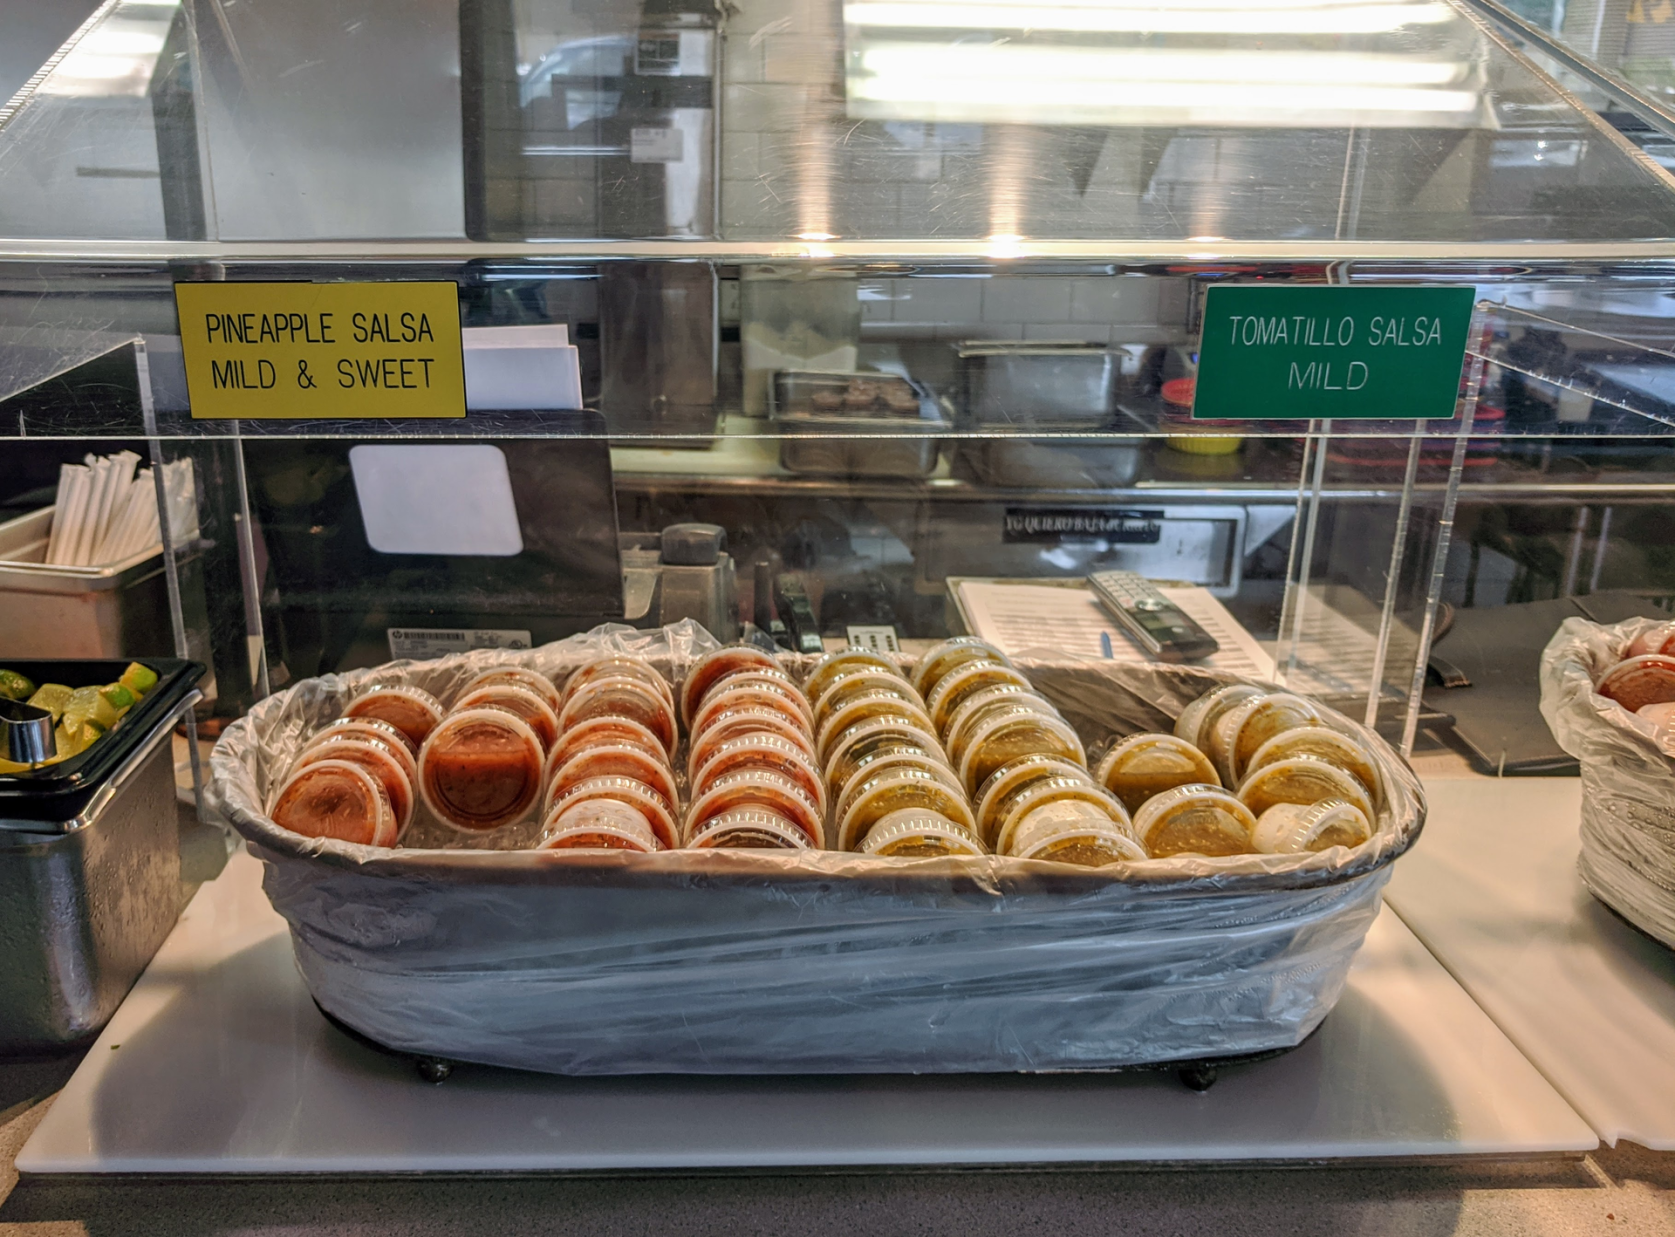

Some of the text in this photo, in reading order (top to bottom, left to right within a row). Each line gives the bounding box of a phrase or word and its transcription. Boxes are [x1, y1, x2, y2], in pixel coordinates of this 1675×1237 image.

[205, 311, 435, 344] PINEAPPLE SALSA
[1229, 315, 1442, 346] TOMATILLO SALSA
[211, 358, 435, 390] MILD & SWEET
[1288, 361, 1369, 390] MILD
